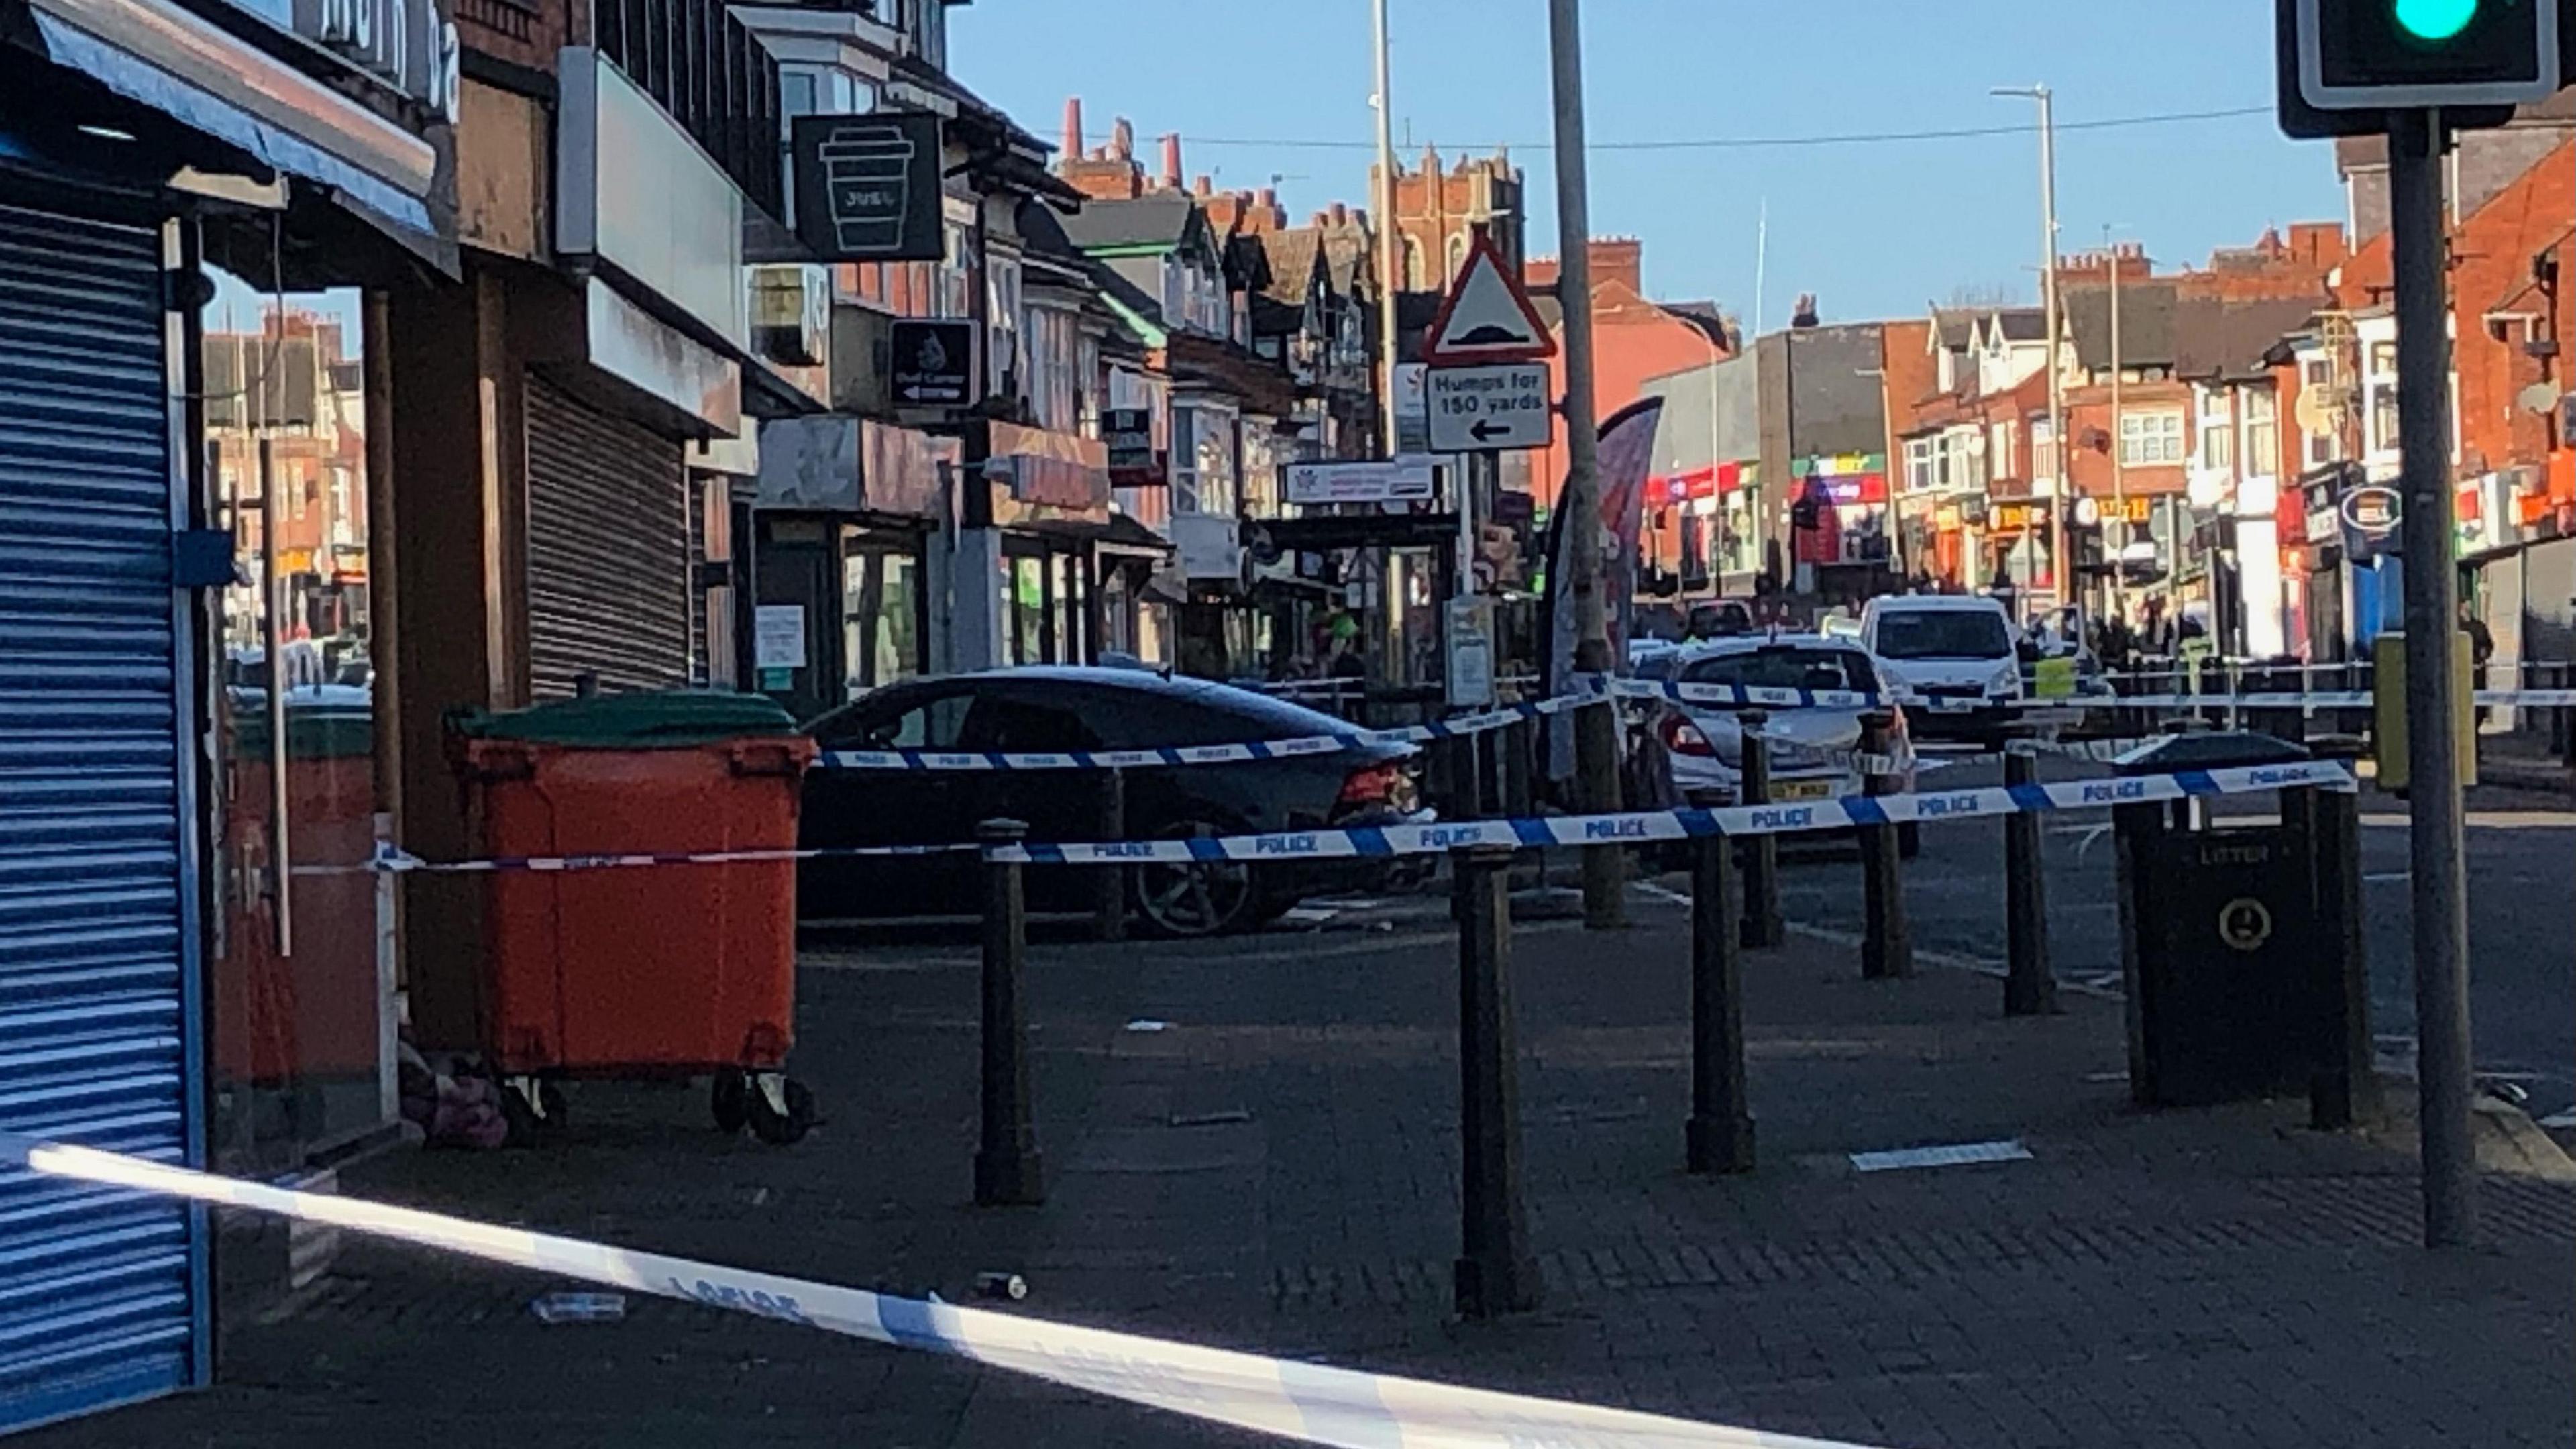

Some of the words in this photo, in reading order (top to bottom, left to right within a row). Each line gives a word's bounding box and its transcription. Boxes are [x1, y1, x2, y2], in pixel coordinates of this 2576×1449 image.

[1434, 375, 1505, 393] Humps
[1511, 372, 1538, 389] for
[1442, 396, 1479, 414] 150
[1488, 394, 1543, 414] yards
[2249, 769, 2310, 785] POLICE
[2083, 782, 2144, 802] POLICE
[1917, 794, 1978, 815] POLICE
[1752, 807, 1813, 828] POLICE
[1419, 826, 1482, 847] POLICE
[1585, 818, 1648, 839] POLICE
[1093, 841, 1155, 857] POLICE
[1255, 835, 1318, 854] POLICE
